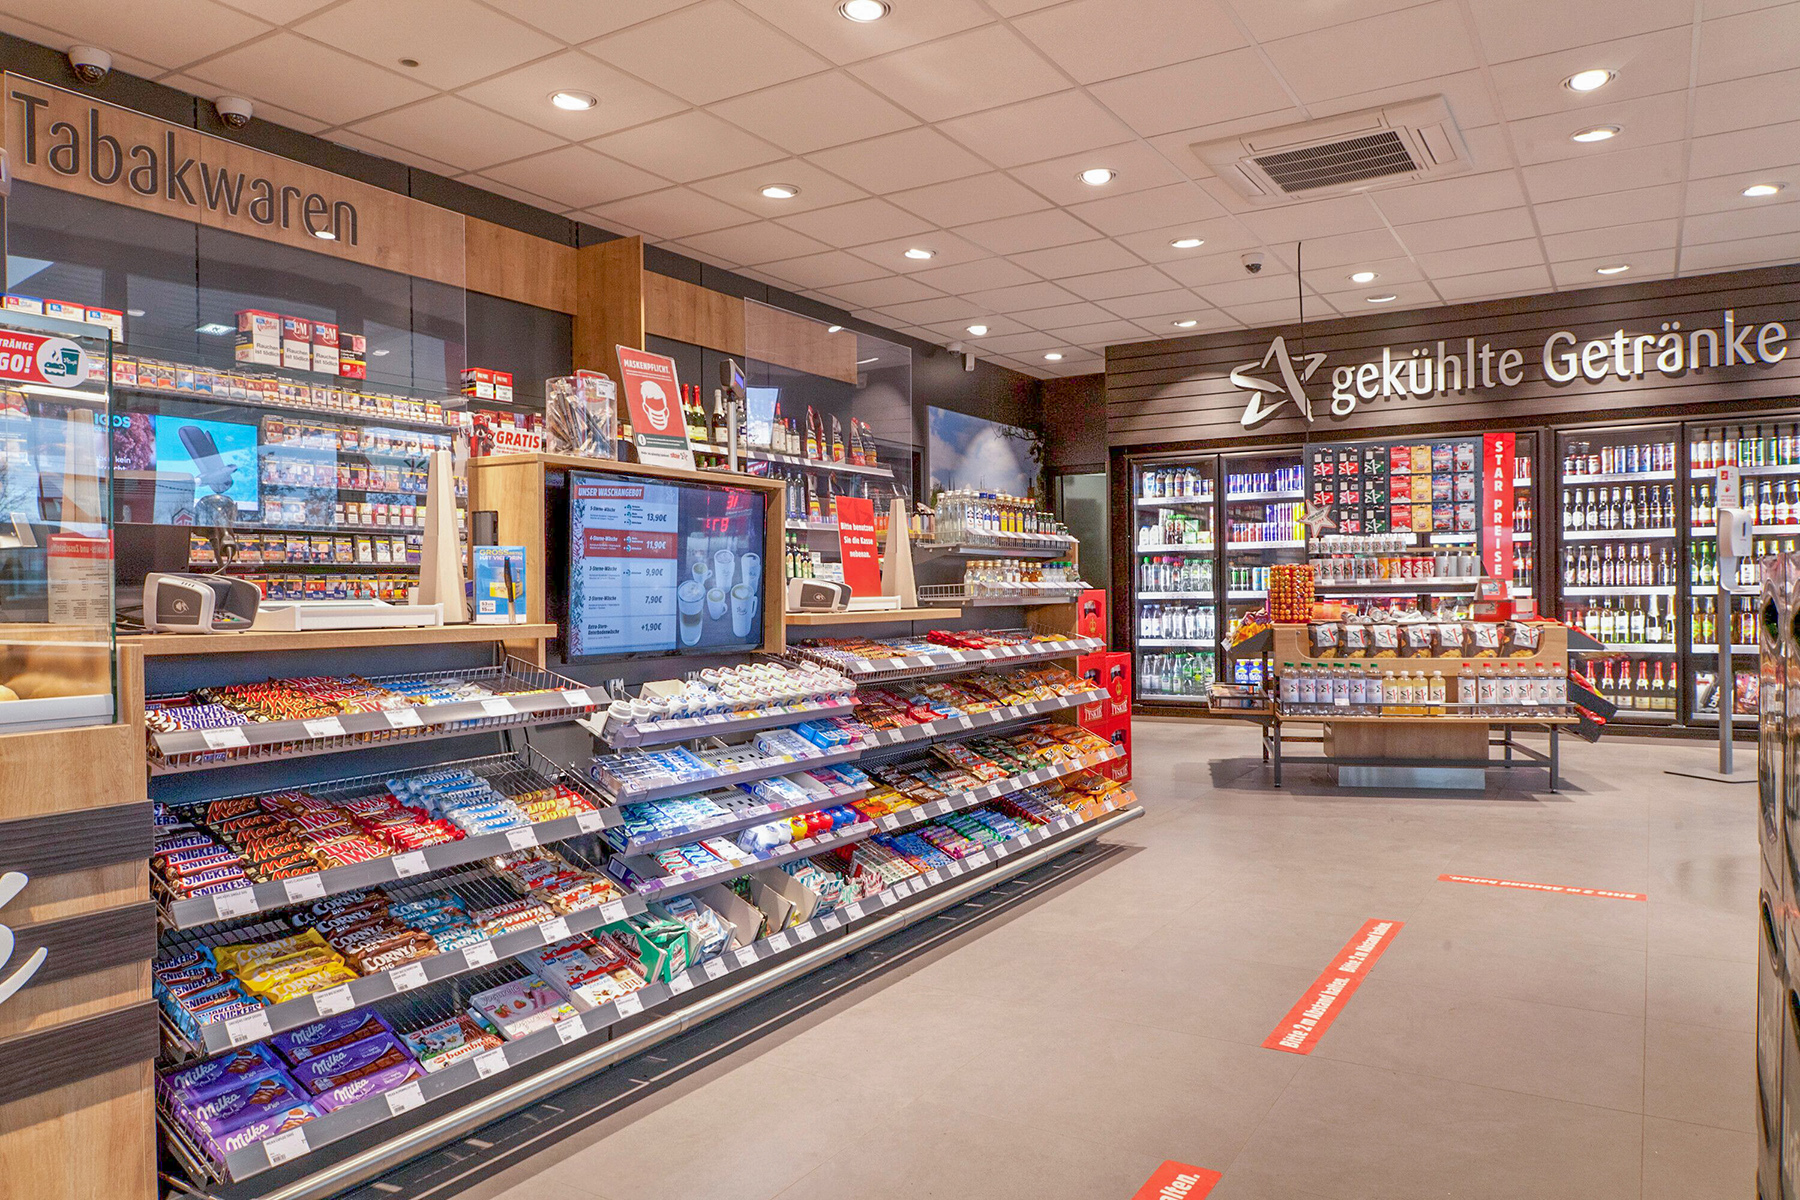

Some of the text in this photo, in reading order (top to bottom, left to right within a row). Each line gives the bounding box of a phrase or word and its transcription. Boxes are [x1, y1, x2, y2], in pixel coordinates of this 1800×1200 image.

[11, 91, 358, 246] Tabakwaren
[0, 352, 33, 374] GO!
[623, 359, 671, 374] MASKENPFLICHT.
[1331, 310, 1788, 416] gekühlte Getränke
[496, 430, 540, 449] GRATIS
[1494, 441, 1503, 492] STAR
[578, 488, 642, 497] UNSER WASCHANGEBOT
[647, 513, 667, 522] 13,90€
[841, 522, 874, 531] Bitte benutzen
[646, 540, 666, 550] 11,90€
[852, 536, 860, 544] die
[860, 536, 873, 545] Kasse
[1494, 499, 1503, 575] PREISE
[850, 550, 871, 558] nebenan.
[645, 568, 663, 577] 9,90€
[645, 596, 662, 604] 7,90€
[641, 623, 661, 631] +1,90€
[160, 703, 224, 716] SNICKERS
[285, 706, 339, 720] Mars
[182, 714, 246, 730] SNICKERS
[339, 797, 385, 814] TWIX
[513, 790, 543, 804] LION
[527, 800, 557, 814] LION
[539, 808, 568, 822] LION
[223, 815, 269, 833] Mars
[288, 810, 341, 832] TWIX
[237, 823, 285, 843] Mars
[297, 825, 352, 846] TWIX
[154, 834, 212, 852] SNICKERS
[246, 832, 294, 855] Mars
[254, 841, 302, 863] Mars
[313, 840, 370, 856] TWIX
[170, 845, 229, 862] SNICKERS
[181, 852, 239, 870] SNICKERS
[260, 852, 308, 874] Mars
[326, 842, 384, 865] TWIX
[184, 865, 243, 885] SNICKERS
[272, 866, 319, 881] Mars
[528, 865, 547, 875] bueno
[193, 878, 252, 897] SNICKERS
[562, 882, 580, 891] bueno
[312, 892, 366, 915] CORNY
[393, 898, 440, 917] CORNY
[485, 900, 527, 916] BOUNTY
[576, 895, 595, 905] bueno
[332, 907, 345, 915] BIG
[499, 910, 539, 925] BOUNTY
[316, 909, 371, 933] CORNY
[336, 924, 350, 932] BIG
[329, 924, 384, 949] CORNY
[152, 951, 197, 971] SNICKERS
[237, 938, 296, 965] CORNY
[361, 945, 417, 971] CORNY
[1338, 960, 1362, 973] Bitte
[1355, 934, 1383, 953] Abstand
[160, 968, 204, 982] SNICKERS
[380, 963, 395, 971] BIG
[175, 974, 221, 996] SNICKERS
[271, 970, 331, 996] CORNY
[184, 989, 229, 1009] SNICKERS
[213, 1004, 260, 1023] SNICKERS
[1279, 977, 1350, 1049] Bitte 2 m Abstand halten.
[291, 1023, 326, 1045] Milka
[312, 1052, 347, 1074] Milka
[174, 1062, 217, 1089] Milka
[333, 1079, 369, 1102] Milka
[196, 1093, 240, 1120] Milka
[226, 1122, 269, 1151] Milka
